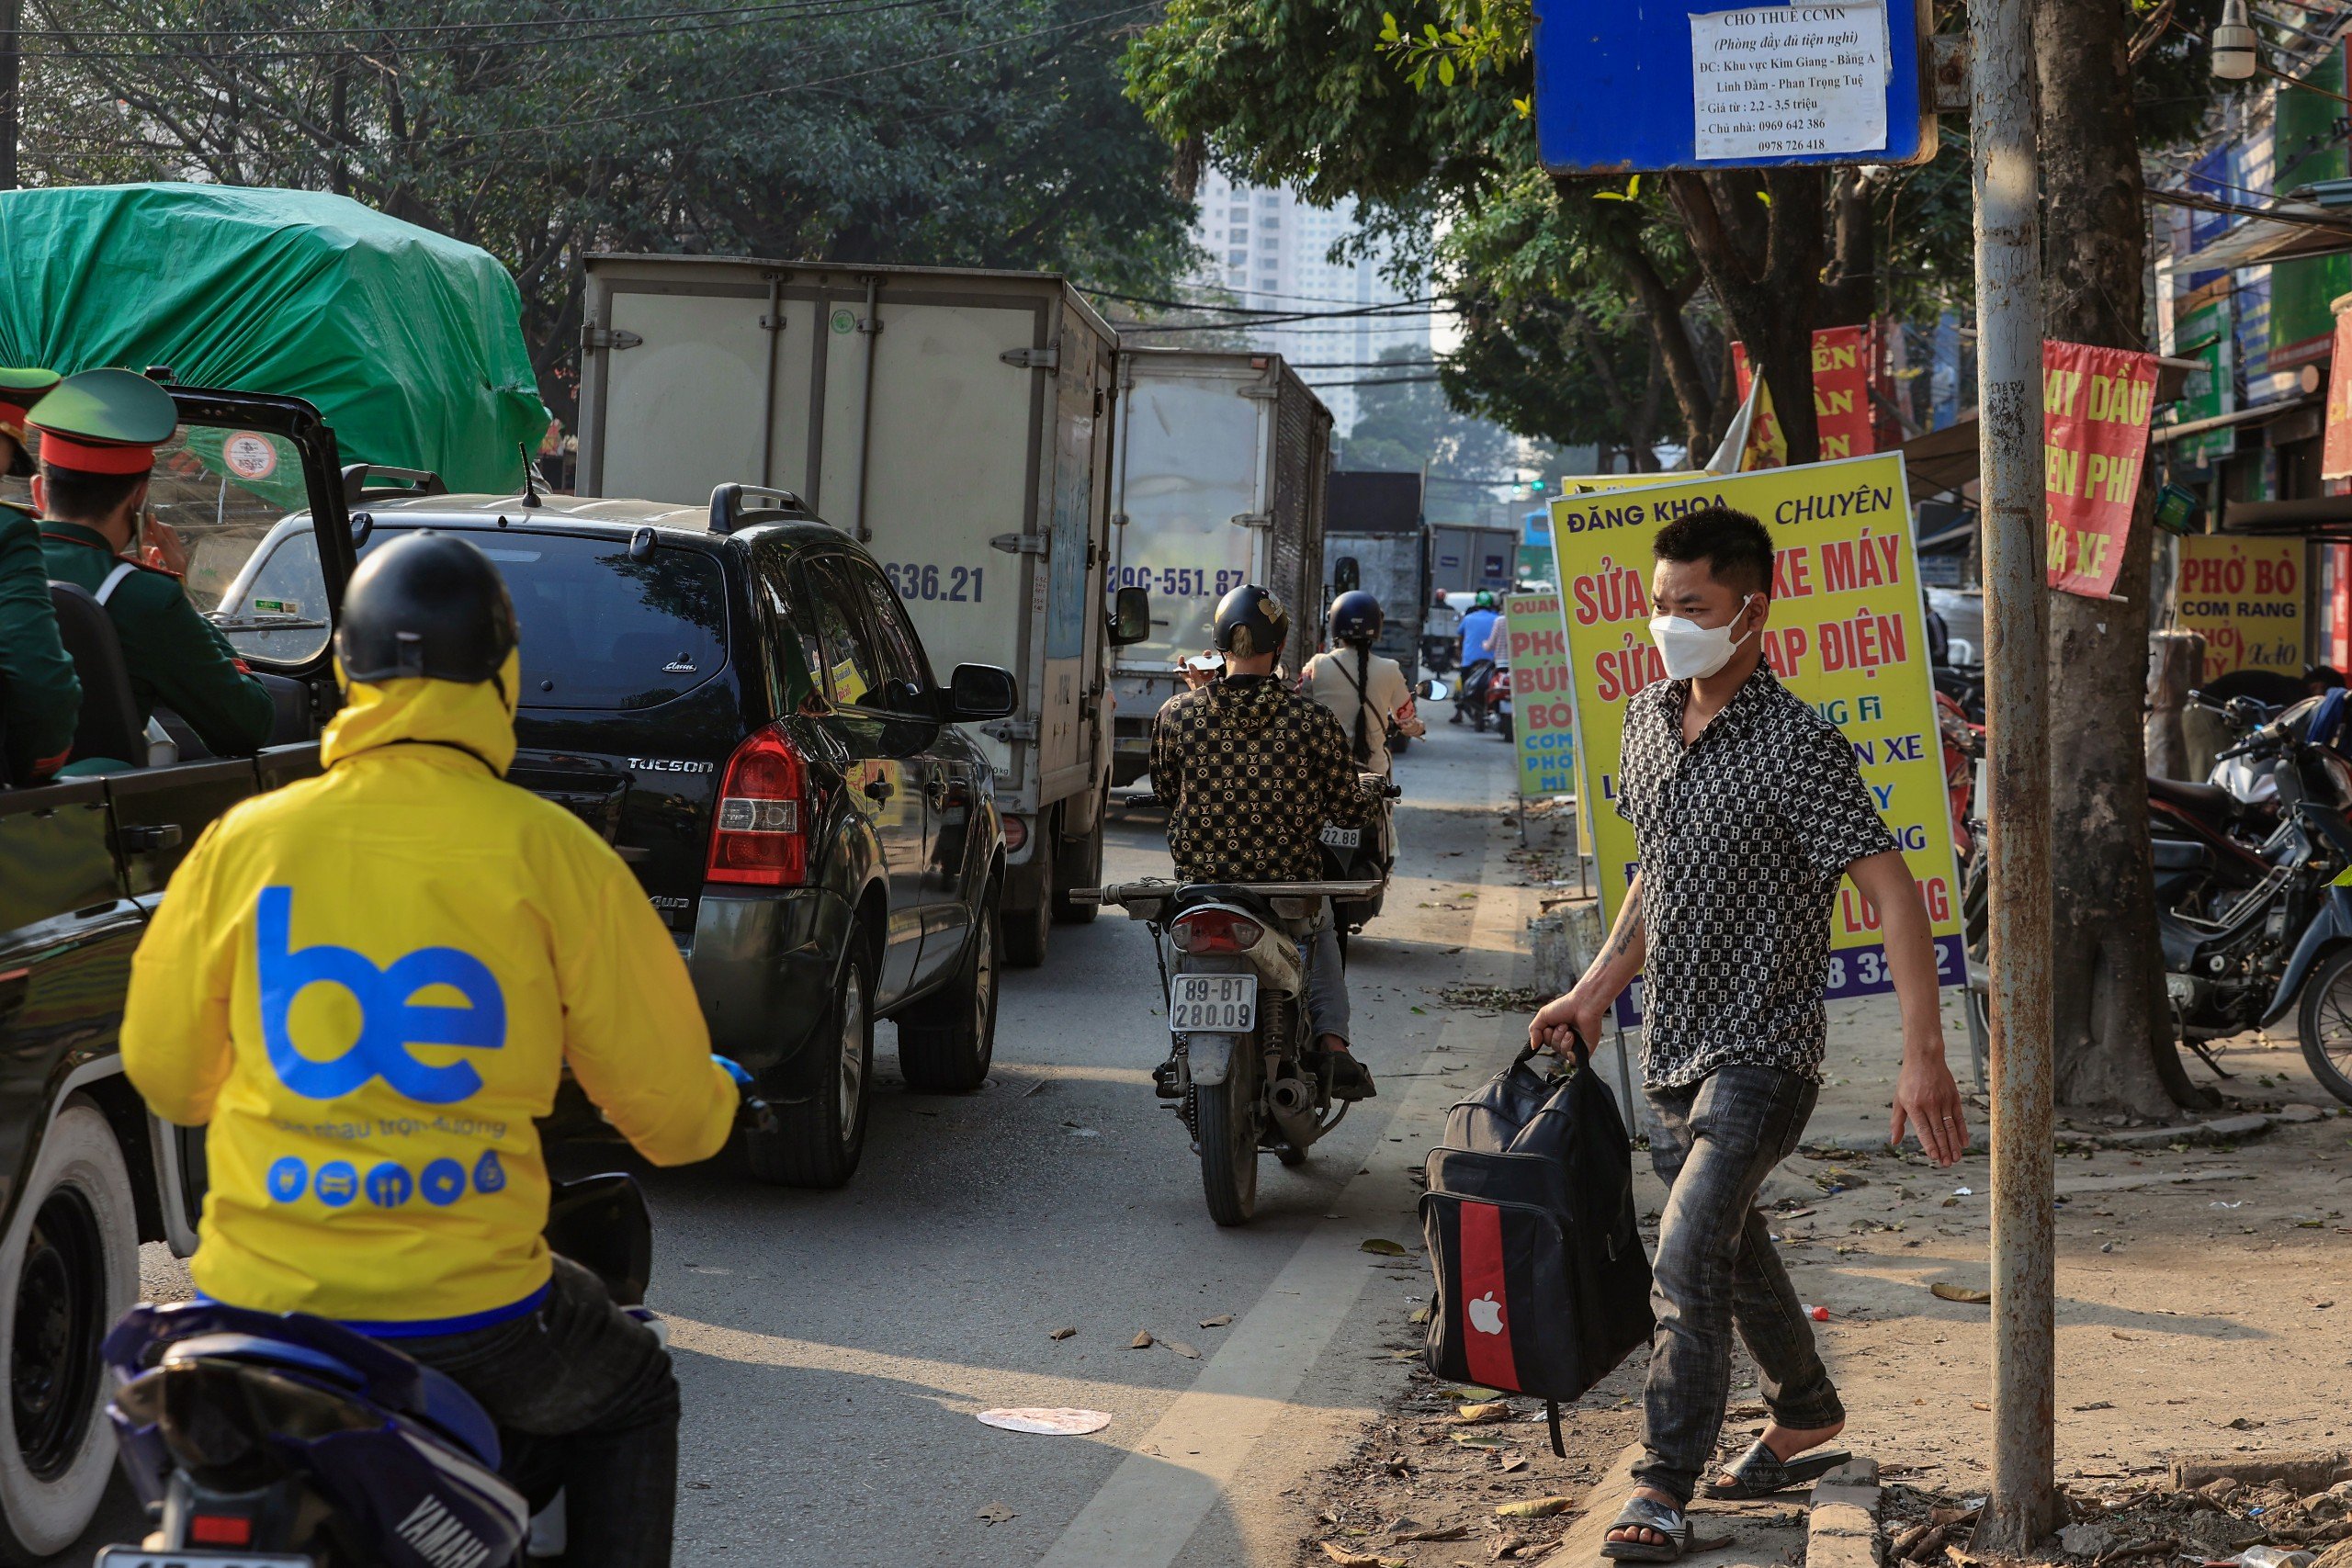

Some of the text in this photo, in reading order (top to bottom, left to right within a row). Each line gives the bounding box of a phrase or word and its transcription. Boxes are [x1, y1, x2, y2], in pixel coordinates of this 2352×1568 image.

[1724, 7, 1846, 27] CHO THUÊ CCMN
[1714, 31, 1858, 52] (Phòng đầy đủ tiện nghi)
[1700, 62, 1720, 73] ĐC:
[1724, 61, 1746, 72] Khu
[1749, 62, 1767, 73] vực
[1771, 58, 1792, 69] Kim
[1796, 56, 1827, 70] Giang
[1837, 51, 1863, 66] Bằng
[1867, 53, 1875, 63] A
[1717, 82, 1741, 92] Linh
[1745, 79, 1769, 91] Đàm
[1779, 79, 1805, 89] Phan
[1808, 76, 1840, 90] Trọng
[1843, 74, 1863, 86] Tuệ
[1707, 101, 1725, 113] Giá
[1729, 101, 1741, 112] từ
[1750, 100, 1765, 112] 2,2
[1775, 99, 1790, 111] 3,5
[1792, 98, 1817, 110] triệu
[1708, 122, 1730, 134] Chủ
[1733, 122, 1756, 133] nhà:
[1758, 121, 1783, 131] 0969
[1786, 119, 1804, 130] 642
[1806, 118, 1826, 130] 386
[1758, 139, 1826, 152] 0978 726 418
[2087, 362, 2151, 426] DẦU
[2084, 448, 2138, 504] PHÍ
[1566, 505, 1645, 534] ĐĂNG
[1775, 484, 1894, 525] CHUYÊN
[2075, 530, 2111, 579] XE
[1573, 556, 1649, 626] SỬA
[1821, 527, 1900, 593] MÁY
[2181, 544, 2296, 595] PHỞ BÒ
[2236, 602, 2296, 618] RANG
[1817, 606, 1907, 679] ĐIỆN
[1528, 696, 1572, 729] BÒ
[1883, 735, 1924, 763] XE
[627, 757, 714, 773] TUCSON
[1323, 829, 1358, 846] 22.88
[257, 886, 507, 1105] be
[1185, 979, 1242, 1001] 89-B1
[1176, 1004, 1250, 1028] 280.09
